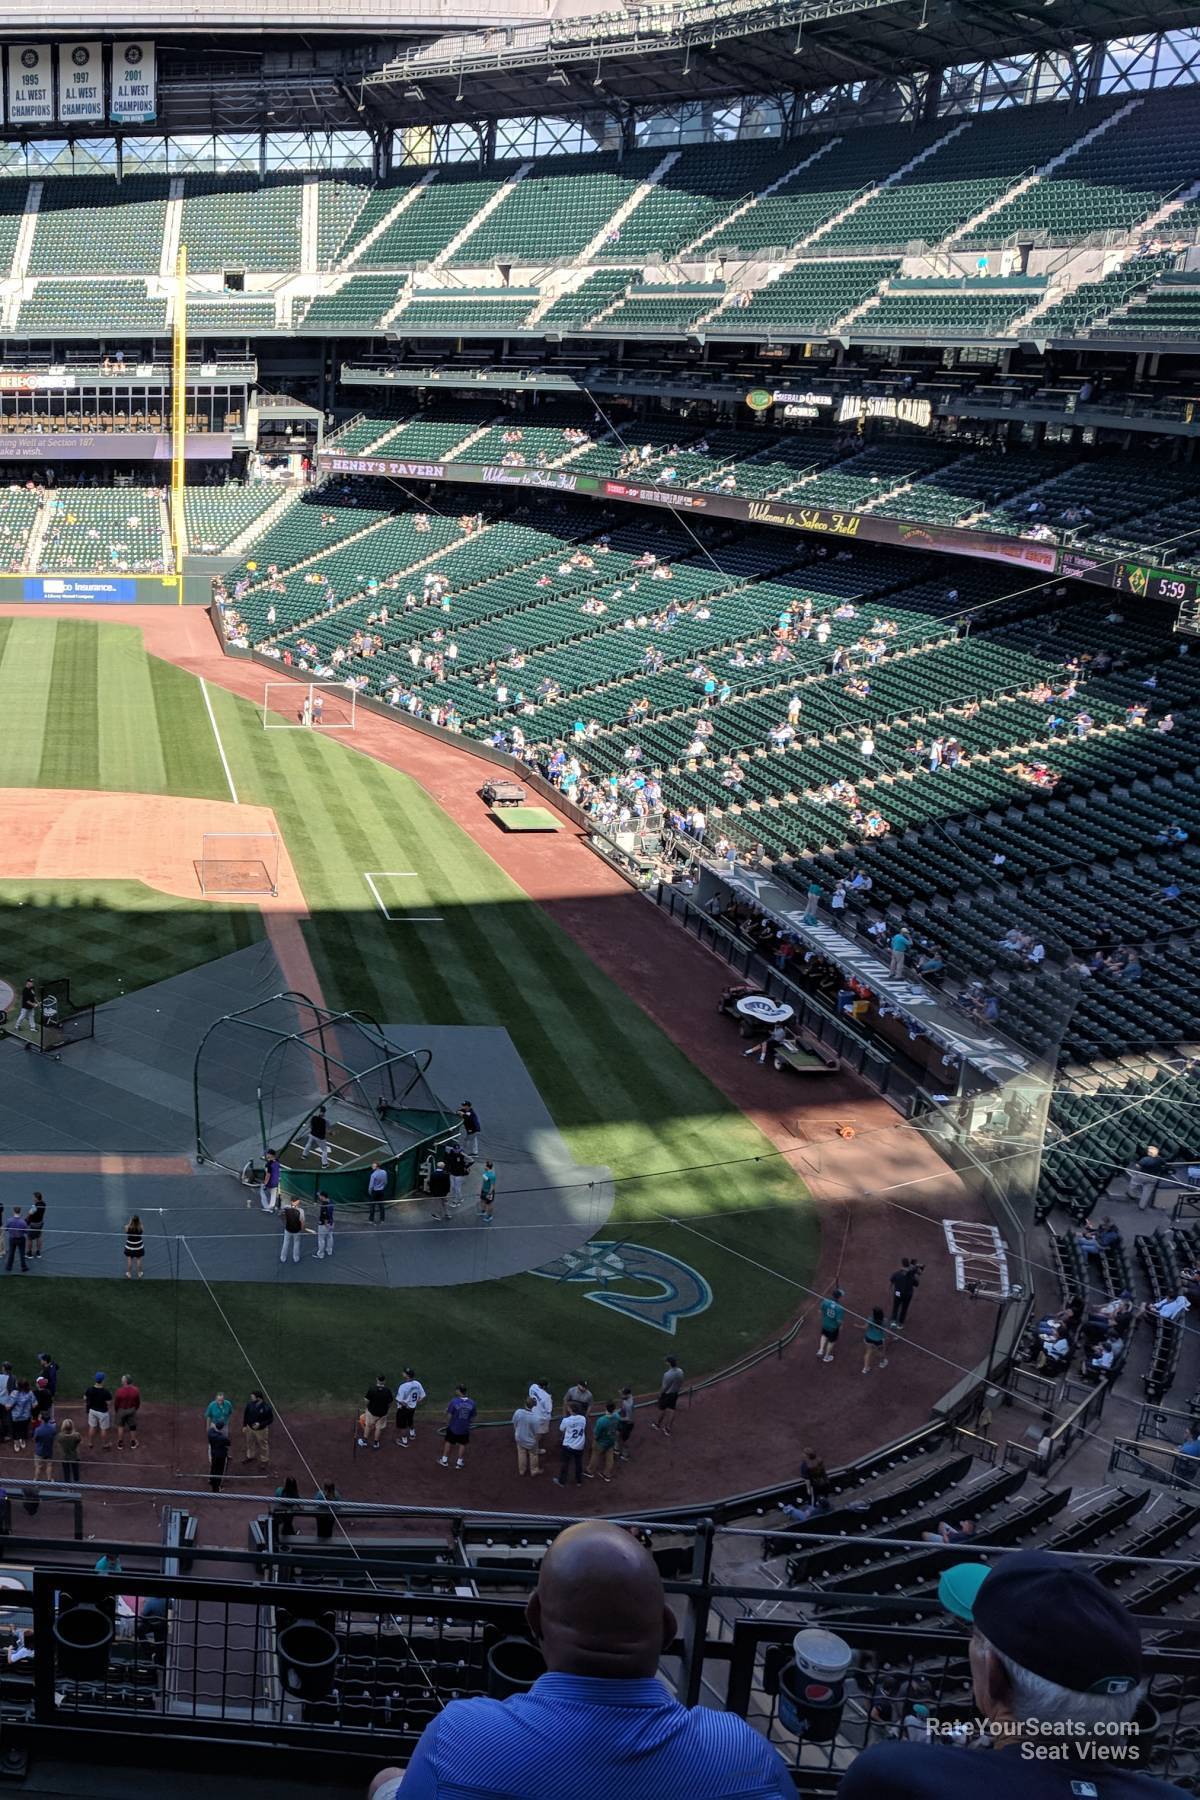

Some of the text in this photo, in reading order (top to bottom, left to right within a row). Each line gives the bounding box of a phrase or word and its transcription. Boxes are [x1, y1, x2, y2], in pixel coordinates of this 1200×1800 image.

[22, 74, 39, 85] 1995
[73, 72, 89, 83] 1997
[124, 70, 142, 81] 2001
[28, 89, 46, 100] WEST
[79, 87, 97, 98] WEST
[131, 85, 149, 96] WEST
[11, 105, 51, 117] CHAMPIONS
[62, 102, 101, 115] CHAMPIONS
[114, 100, 153, 111] CHAMPIONS
[897, 398, 932, 428] CLUB
[19, 439, 36, 447] Well
[47, 438, 77, 447] Section
[22, 448, 43, 456] wish.
[332, 459, 444, 476] HENRY'S TAVERN
[482, 466, 520, 484] Welcome
[523, 474, 531, 484] to
[557, 473, 578, 490] Field
[748, 501, 860, 536] Welcome to Safeco Field
[1158, 579, 1186, 599] 5:59
[571, 1428, 584, 1440] 24
